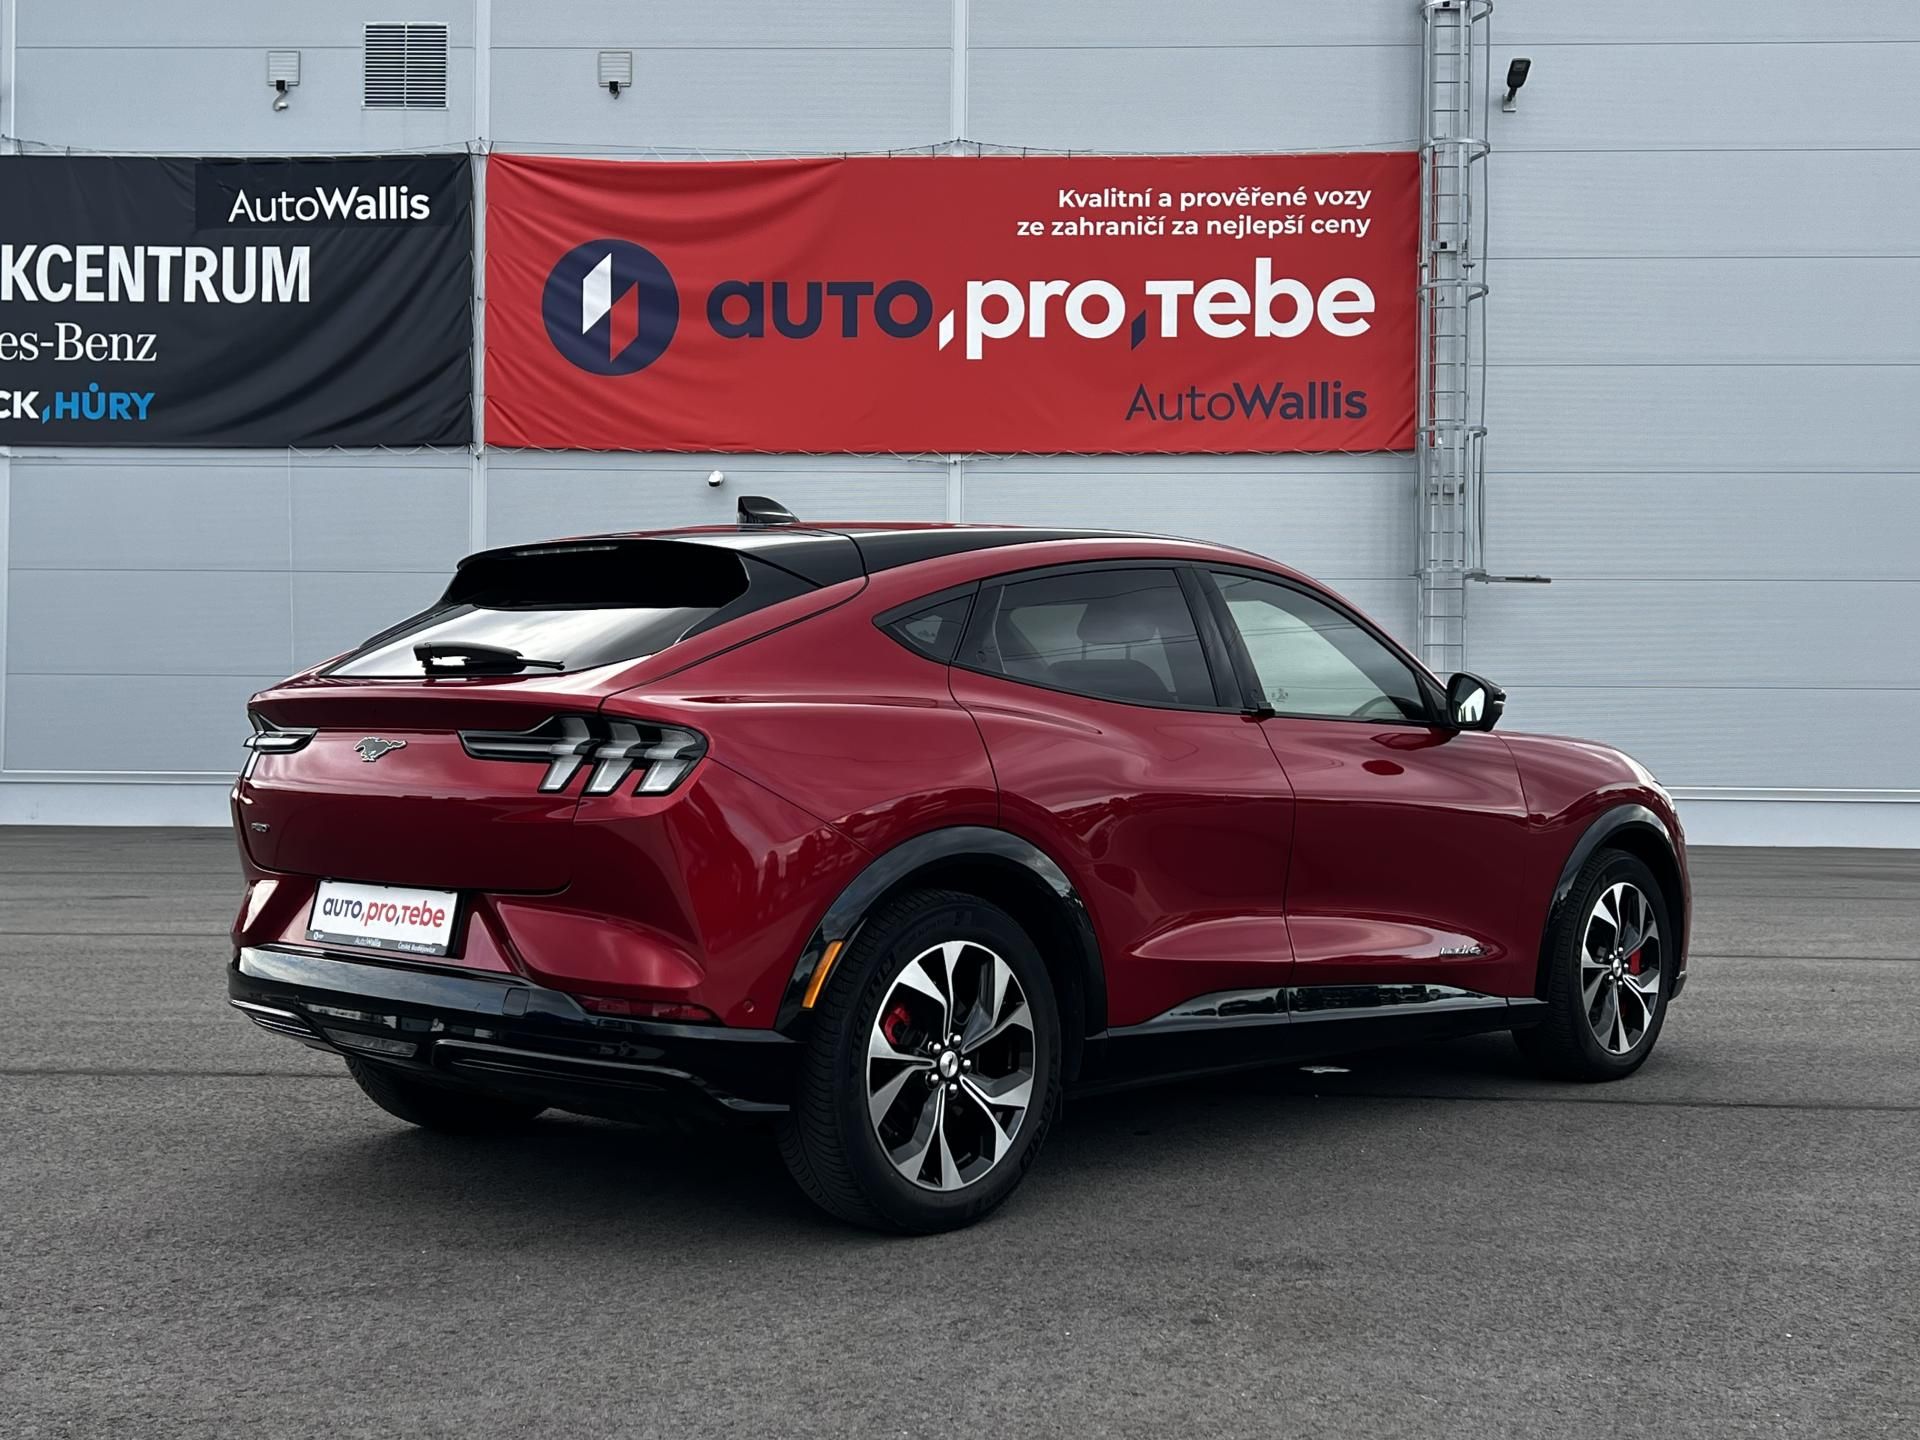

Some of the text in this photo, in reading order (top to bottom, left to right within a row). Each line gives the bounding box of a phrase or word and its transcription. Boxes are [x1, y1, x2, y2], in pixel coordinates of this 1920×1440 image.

[228, 185, 430, 223] AutoWallis
[1058, 186, 1372, 211] Kvalitní a prověřené vozy
[1016, 214, 1371, 239] ze zahraničí za nejlepší ceny
[1, 243, 311, 303] KCENTRUM
[1125, 380, 1368, 422] AutoWallis
